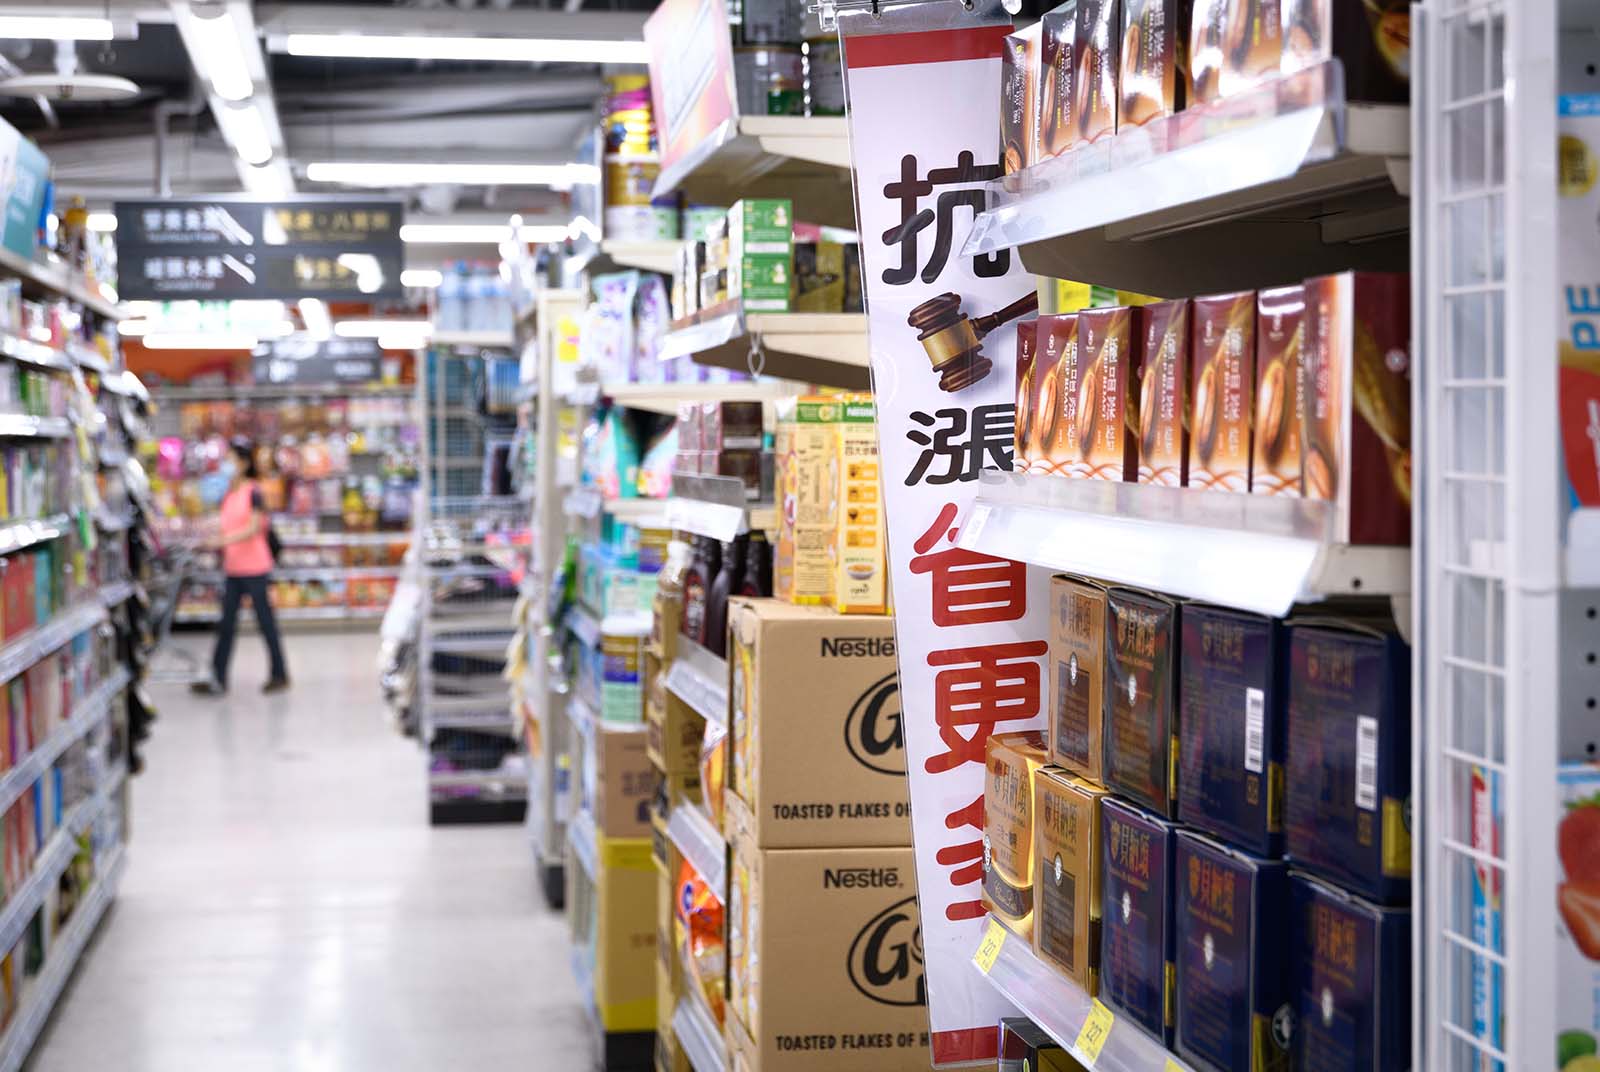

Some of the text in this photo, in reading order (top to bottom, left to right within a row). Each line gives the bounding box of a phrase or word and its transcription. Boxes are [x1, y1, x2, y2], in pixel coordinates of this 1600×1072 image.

[773, 804, 834, 820] TOASTED
[839, 802, 890, 818] FLAKES
[776, 1035, 837, 1051] TOASTED
[842, 1033, 893, 1049] FLAKES
[897, 1033, 915, 1048] OF
